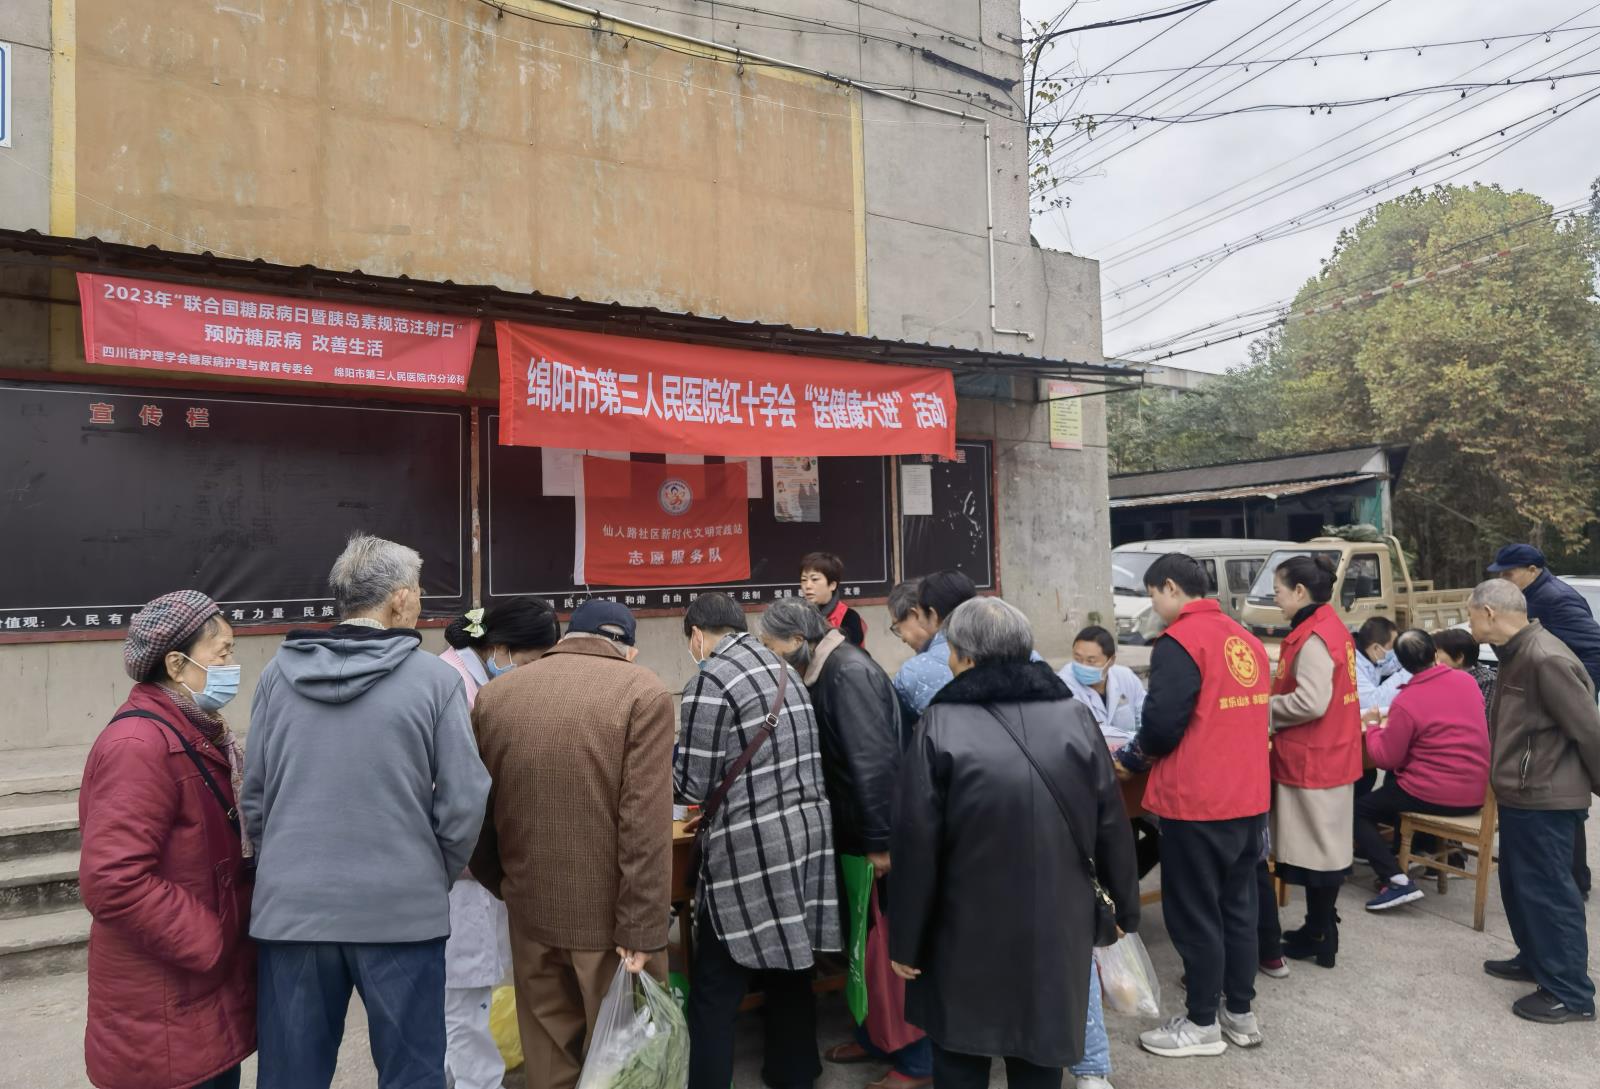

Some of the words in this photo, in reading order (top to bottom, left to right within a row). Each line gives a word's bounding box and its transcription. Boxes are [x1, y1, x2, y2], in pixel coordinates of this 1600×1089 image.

[204, 323, 302, 351] 预防糖尿病
[312, 334, 384, 358] 改善生活
[102, 346, 314, 376] 四川省护理学会糖尿病护理与教育专委会
[334, 366, 465, 386] 绵阳市第三人民医院内分泌科
[526, 357, 796, 429] 绵阳市第三人民医院红十字会
[804, 383, 904, 429] “送健康六进”
[912, 390, 948, 429] 活动
[89, 402, 211, 429] 宣传栏
[628, 547, 723, 566] 志愿服务队
[625, 595, 647, 605] 和谐
[662, 593, 682, 604] 自由
[774, 589, 792, 599] 爱国
[843, 586, 861, 596] 友善
[303, 605, 335, 618] 民族
